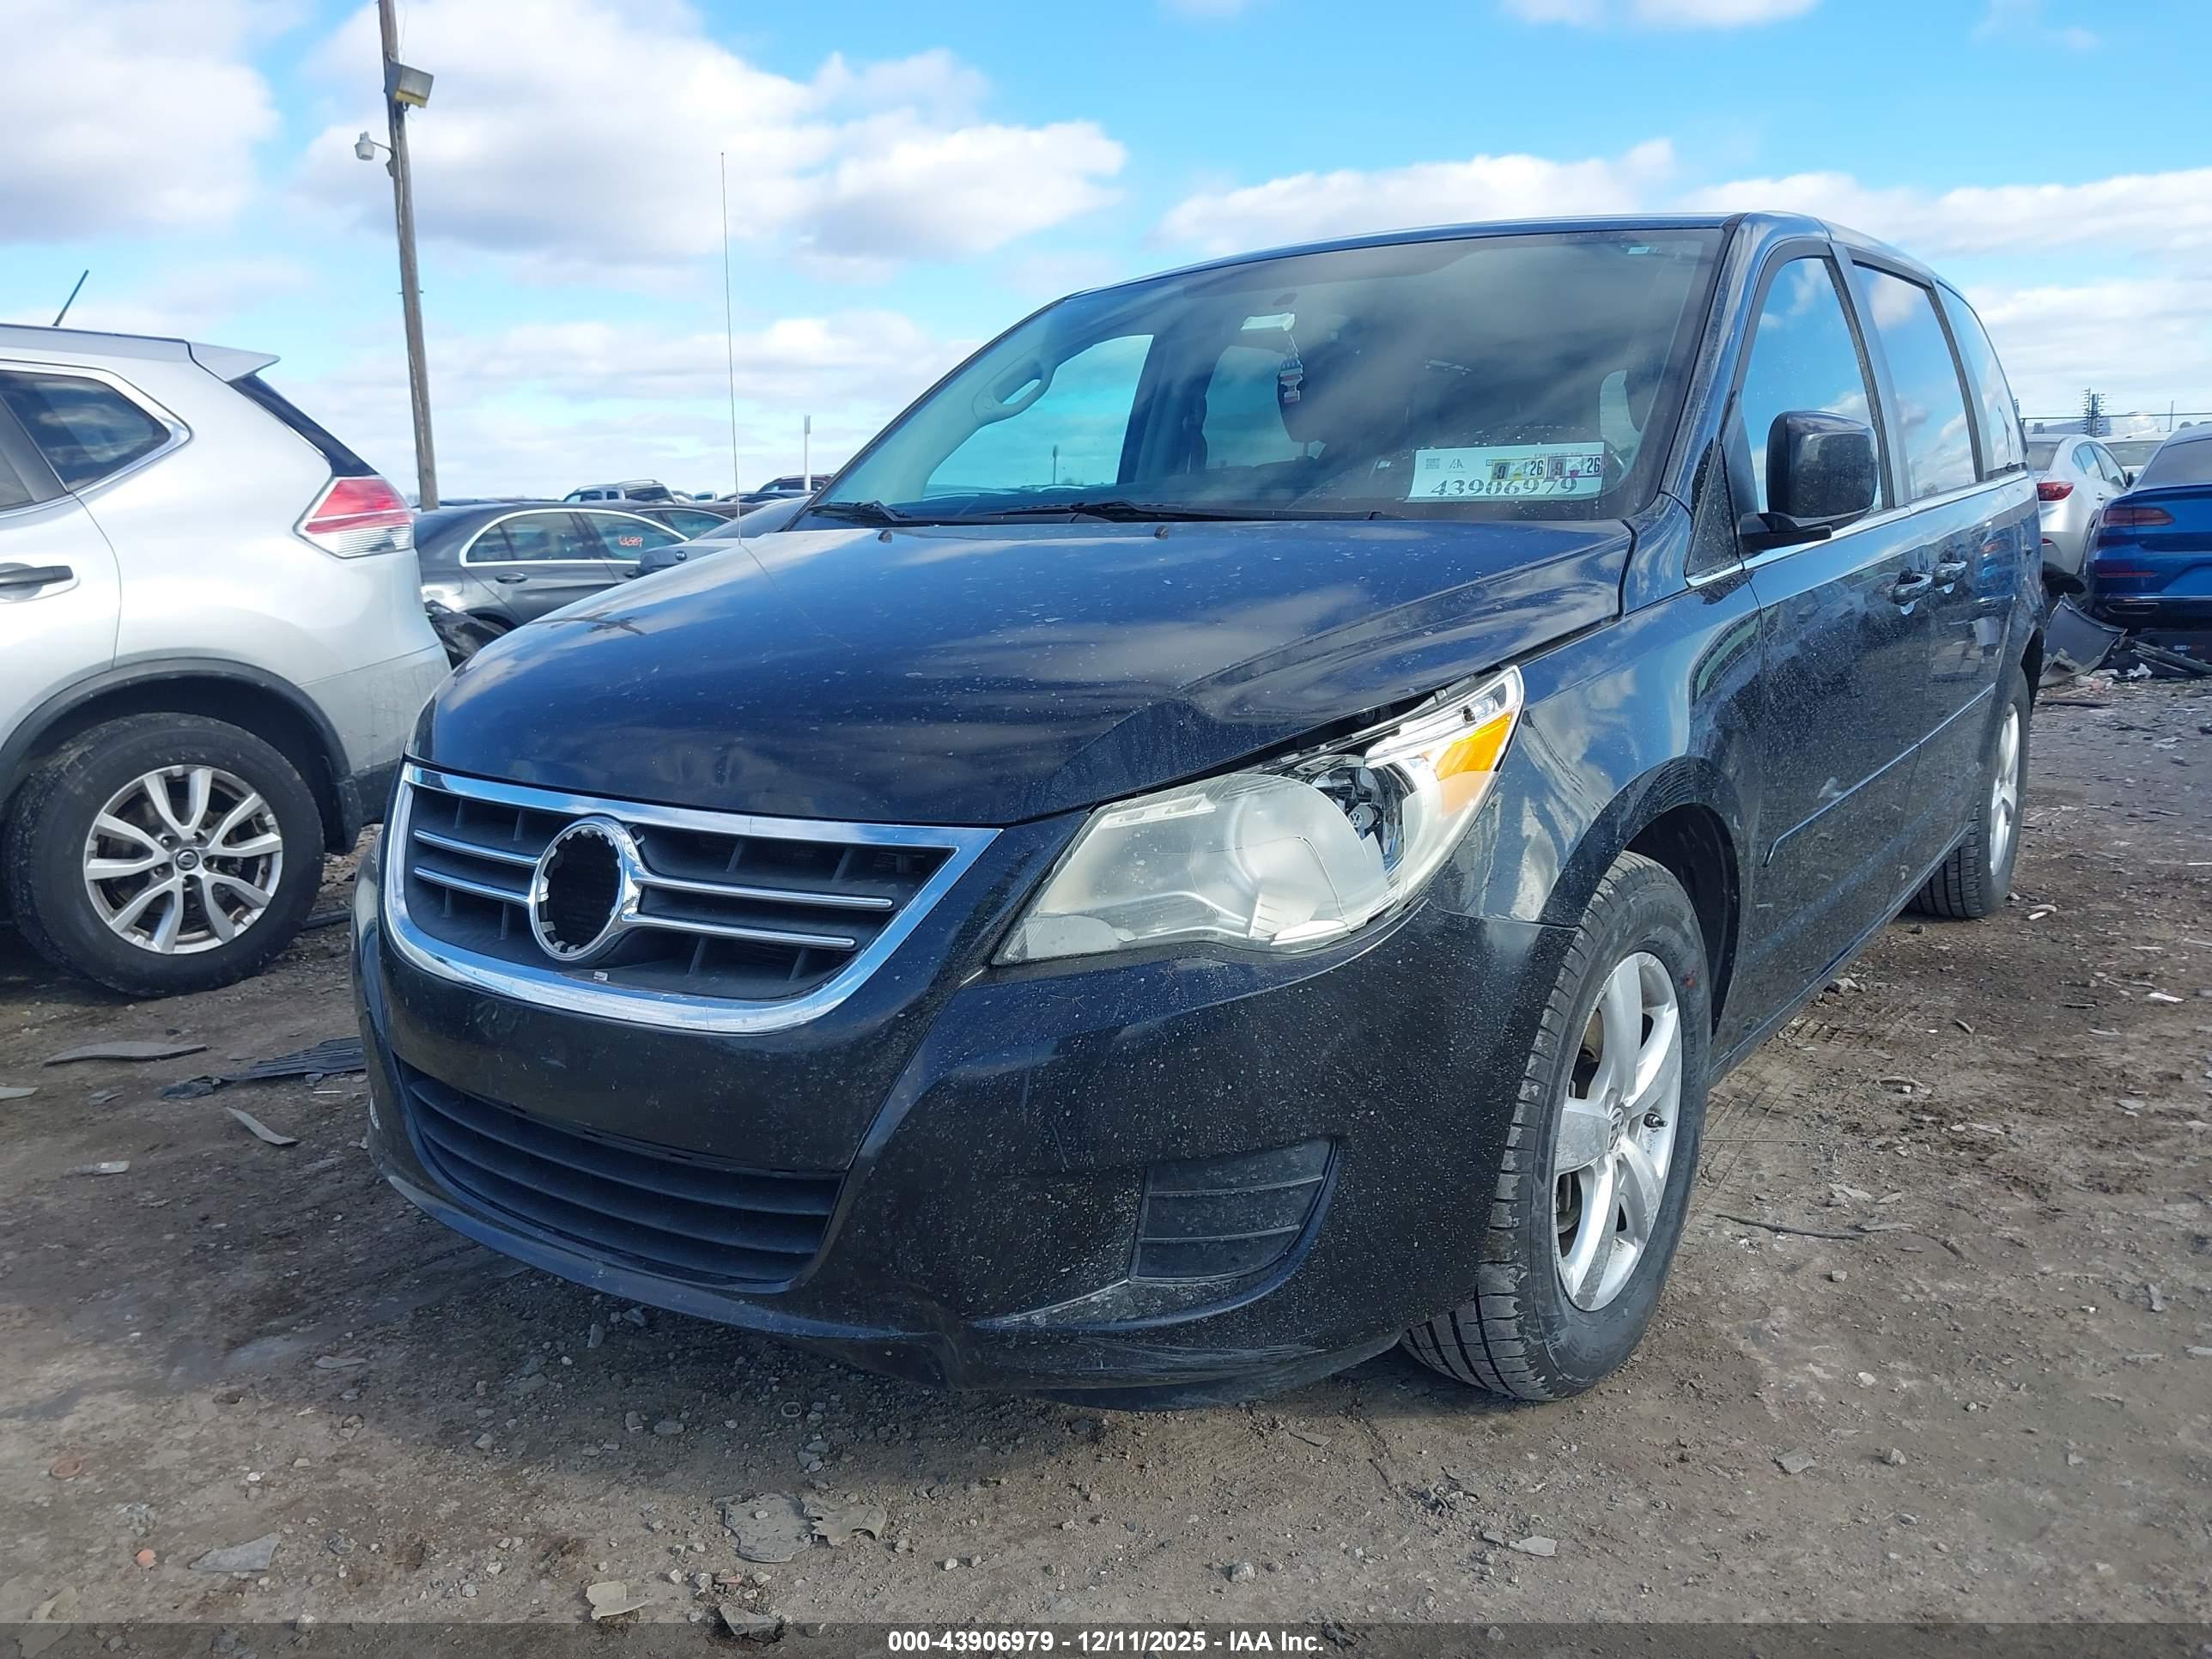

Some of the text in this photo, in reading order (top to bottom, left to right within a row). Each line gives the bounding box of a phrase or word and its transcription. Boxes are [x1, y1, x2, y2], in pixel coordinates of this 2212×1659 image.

[1529, 459, 1544, 477] 26
[1586, 457, 1601, 474] 26
[1431, 478, 1578, 495] 43906979
